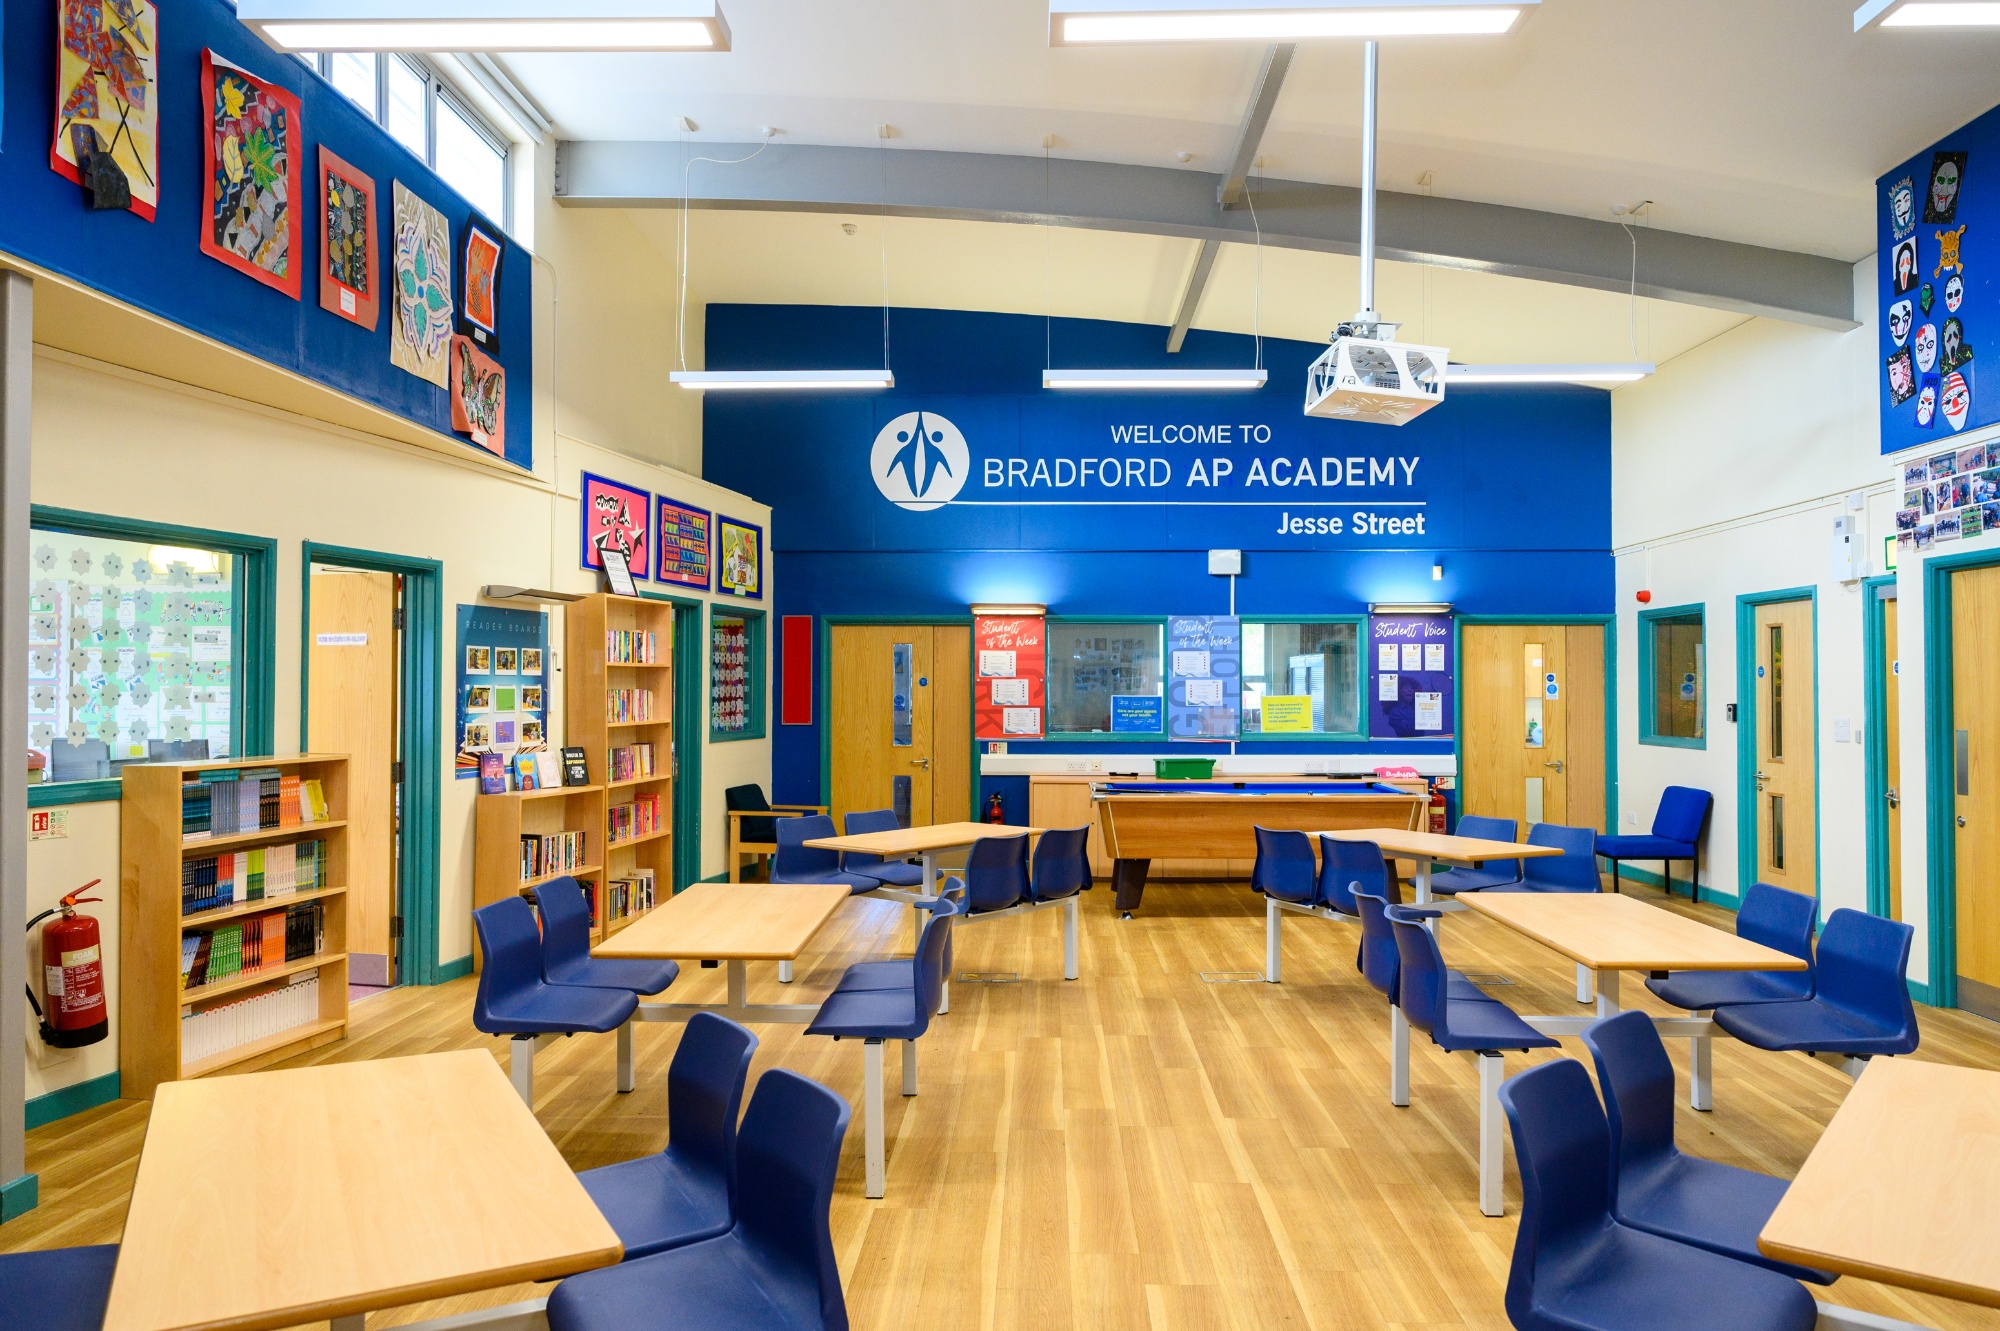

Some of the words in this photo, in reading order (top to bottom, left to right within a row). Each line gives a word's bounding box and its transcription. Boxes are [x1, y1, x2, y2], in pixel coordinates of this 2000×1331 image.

[1111, 425, 1231, 443] WELCOME
[1239, 425, 1271, 443] TO
[985, 458, 1171, 486] BRADFORD
[1187, 458, 1232, 486] AP
[1245, 457, 1419, 486] ACADEMY
[1277, 513, 1342, 534] Jesse
[1352, 512, 1425, 534] Street
[465, 620, 502, 631] READER
[509, 624, 542, 634] BOARDS
[981, 620, 1025, 635] Student
[1174, 620, 1219, 634] Student
[1375, 622, 1423, 638] Student
[1424, 621, 1447, 638] Voice
[985, 637, 996, 649] of
[1016, 633, 1038, 647] Week
[1180, 636, 1189, 649] of
[1210, 633, 1233, 647] Week
[72, 949, 94, 960] FOAM
